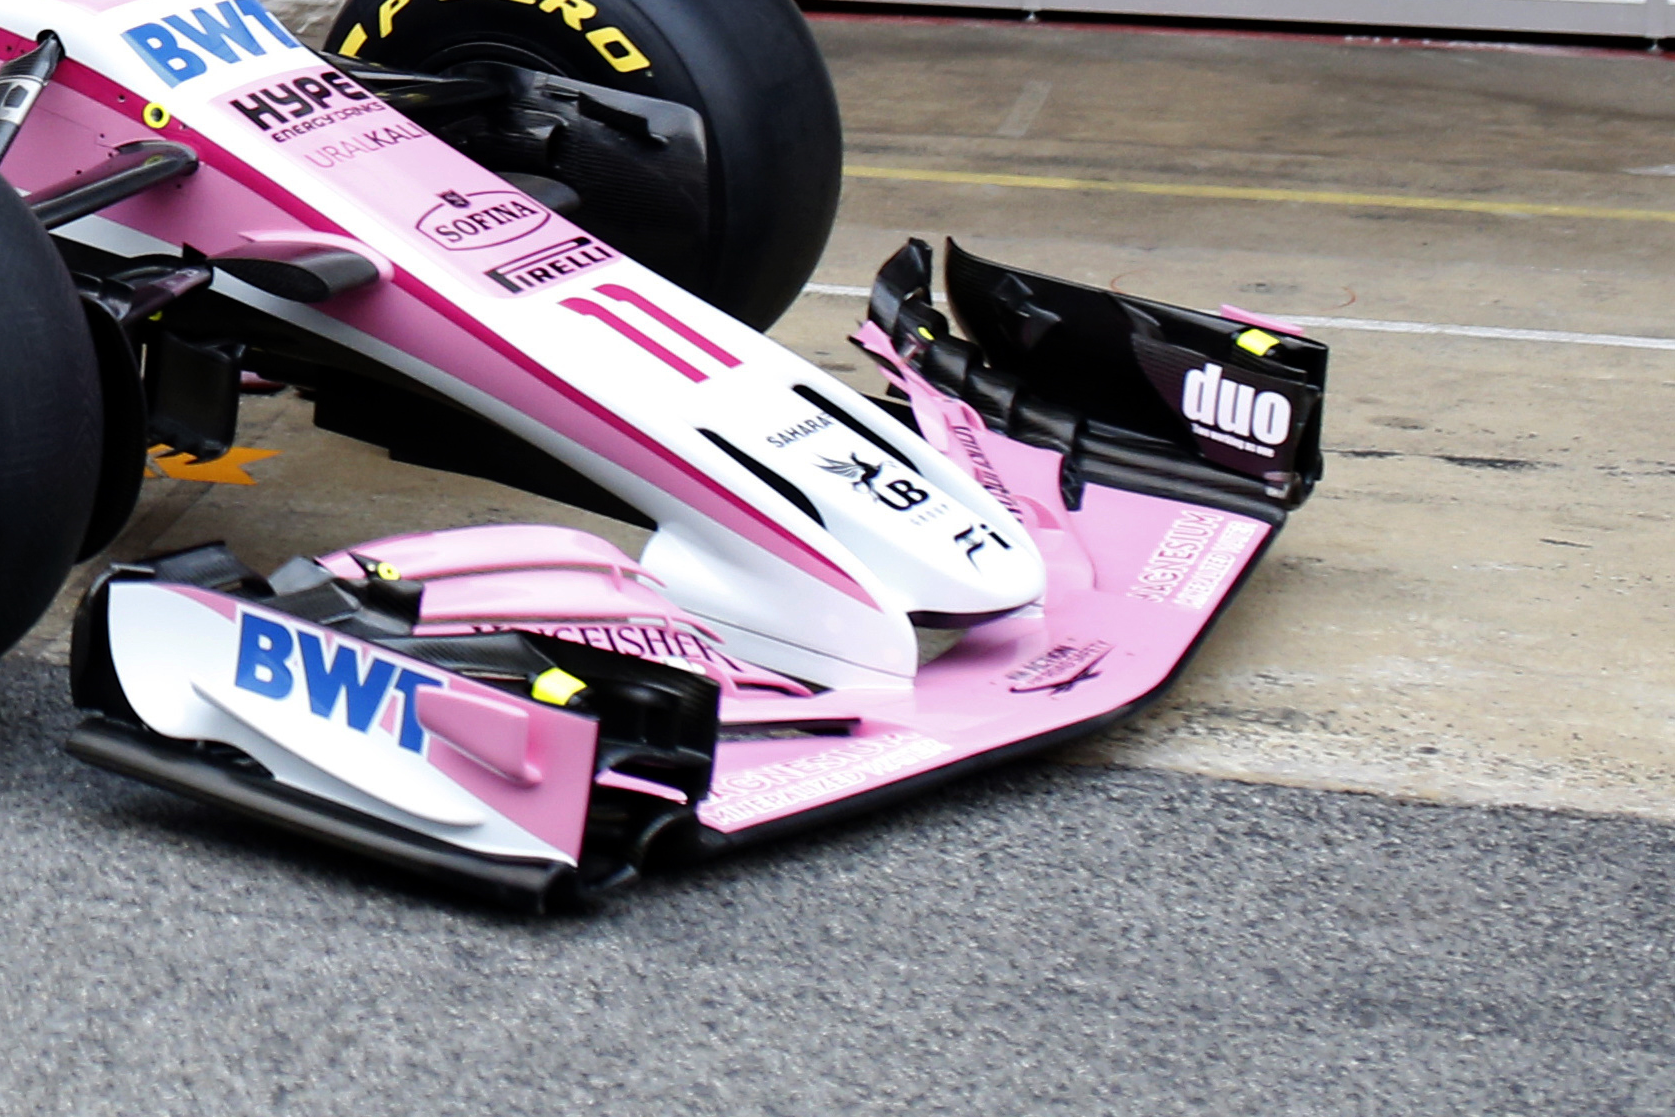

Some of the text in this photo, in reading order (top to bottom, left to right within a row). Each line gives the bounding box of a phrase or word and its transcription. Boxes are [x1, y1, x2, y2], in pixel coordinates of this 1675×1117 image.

[229, 71, 375, 132] HYPE
[271, 101, 387, 143] ENERGY DRINKS
[304, 121, 430, 169] URALKALI
[435, 200, 538, 243] SOFINA
[483, 236, 615, 294] PIRELLI
[557, 283, 745, 384] 11
[766, 412, 835, 448] SAHARA
[1182, 362, 1292, 446] duo
[1127, 509, 1225, 603] MAGNESIUM
[235, 612, 444, 754] BWT
